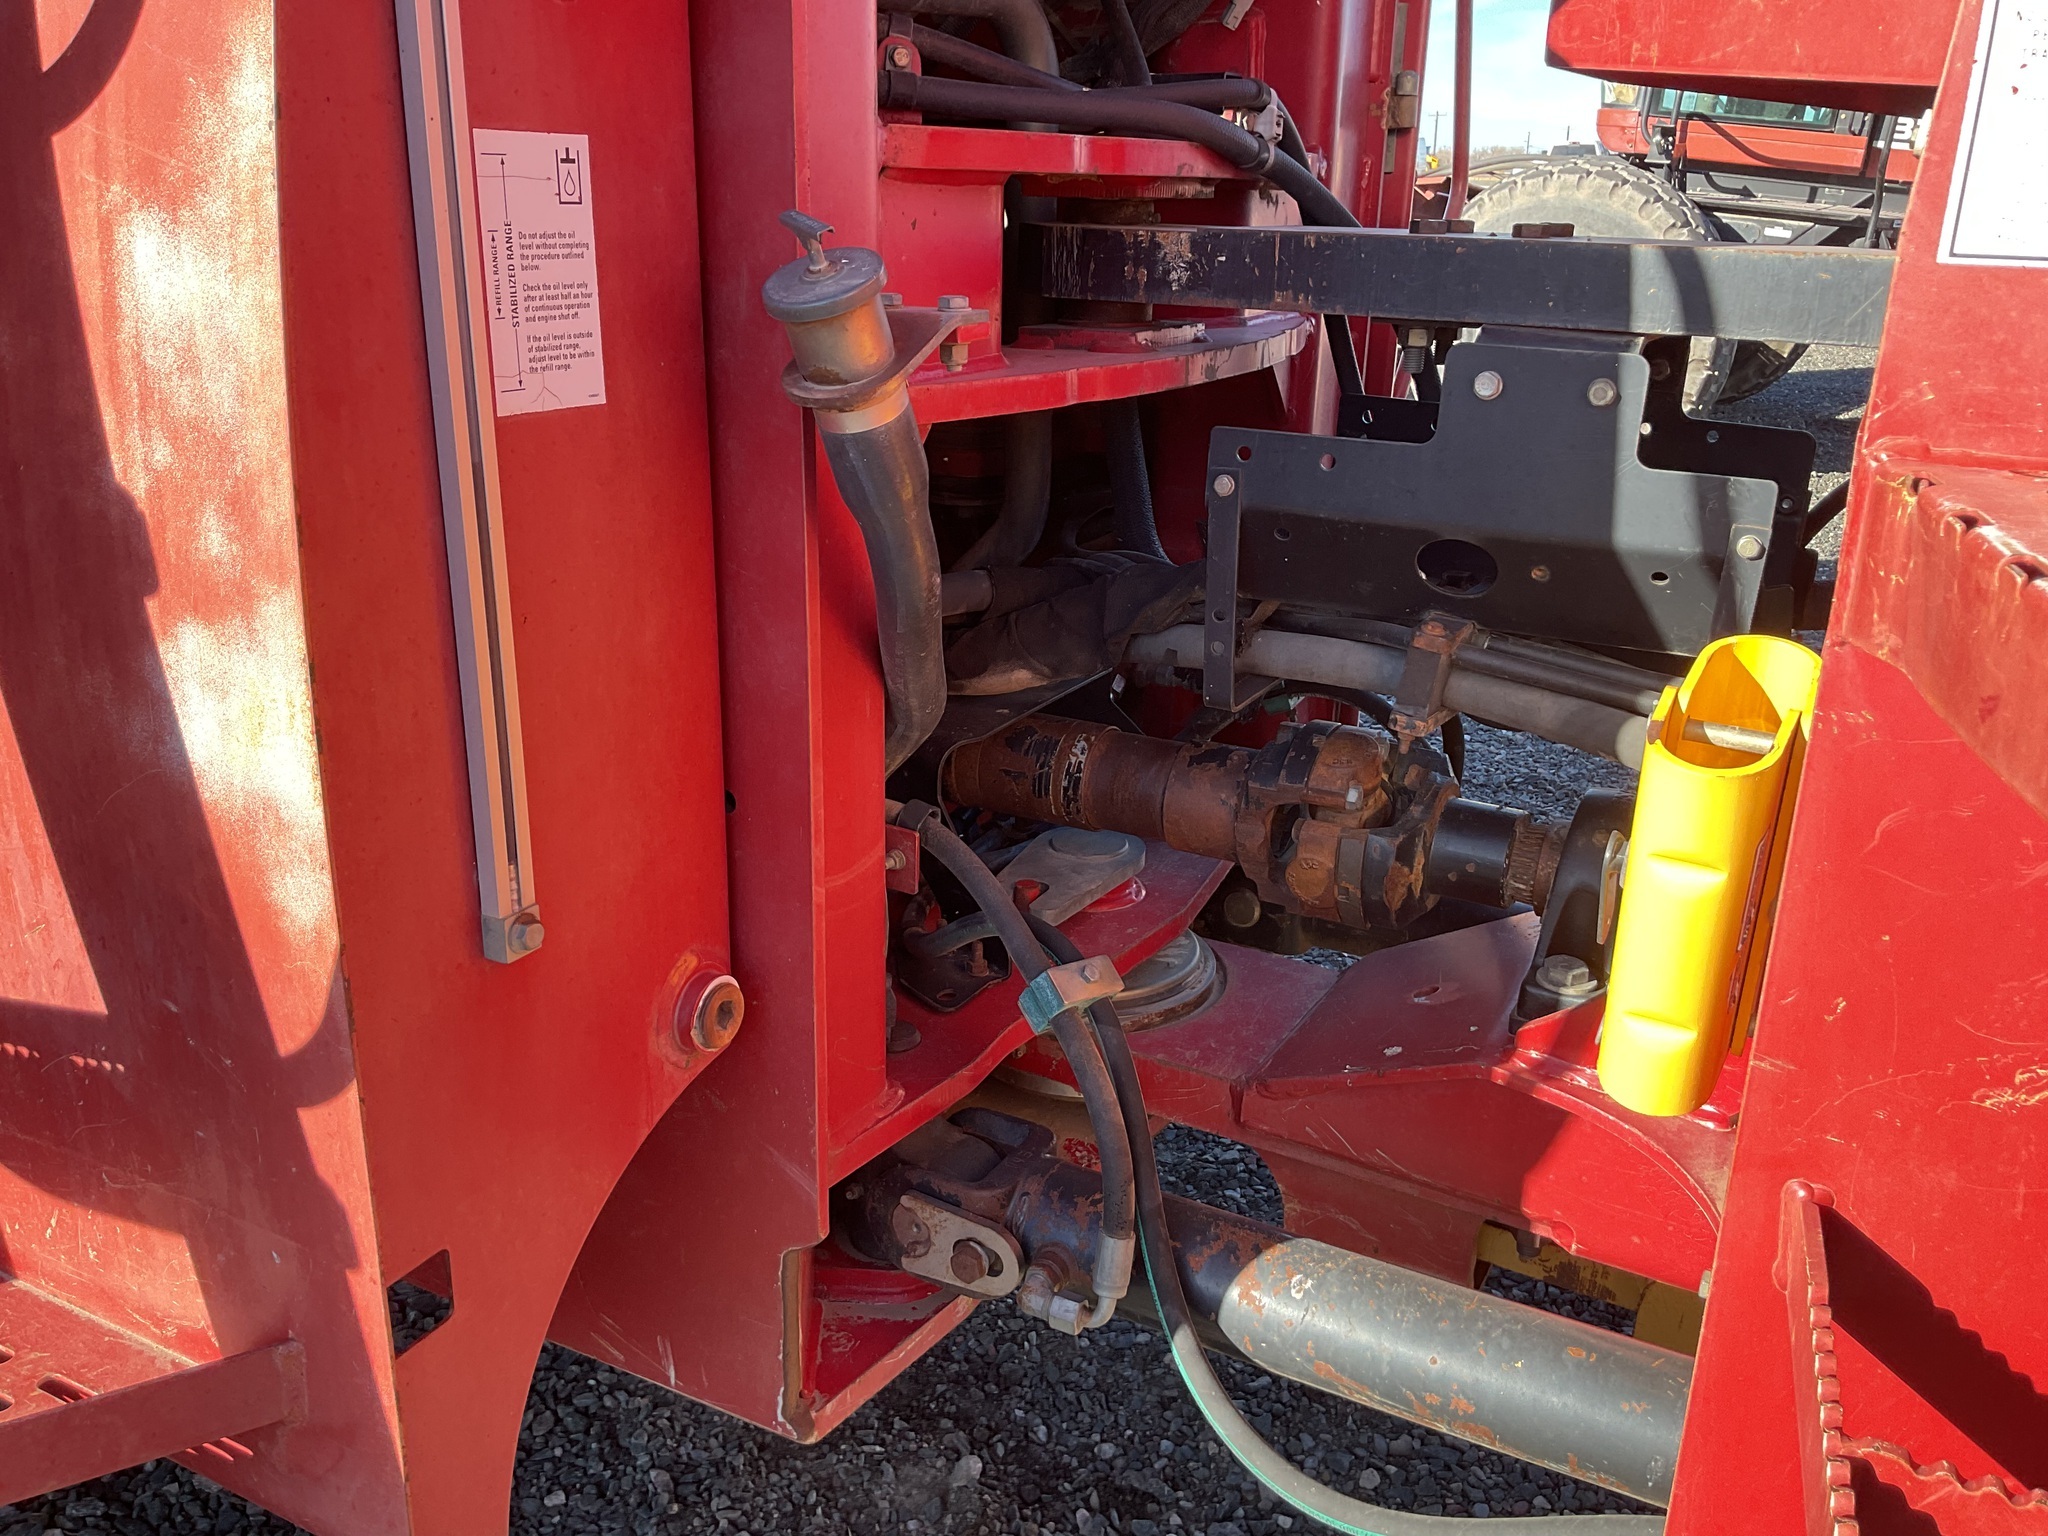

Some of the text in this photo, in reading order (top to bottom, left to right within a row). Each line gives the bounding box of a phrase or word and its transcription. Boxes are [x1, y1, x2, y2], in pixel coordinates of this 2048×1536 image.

[539, 231, 556, 241] adjust
[519, 241, 589, 250] level without completing
[491, 245, 499, 275] RANGE
[531, 252, 560, 262] procedure
[562, 251, 584, 259] outlined
[521, 263, 541, 271] below.
[504, 221, 519, 327] STABILIZED RANGE
[523, 283, 541, 291] Check
[576, 281, 588, 290] only
[524, 294, 537, 302] after
[525, 301, 590, 312] of continuous operation
[538, 313, 557, 323] engine
[527, 335, 531, 343] If
[552, 332, 565, 340] level
[573, 331, 593, 339] outside
[528, 345, 533, 353] of
[535, 343, 562, 352] stabilized
[529, 355, 546, 364] adjust
[578, 350, 595, 358] within
[540, 364, 553, 372] refill
[555, 363, 572, 371] range.
